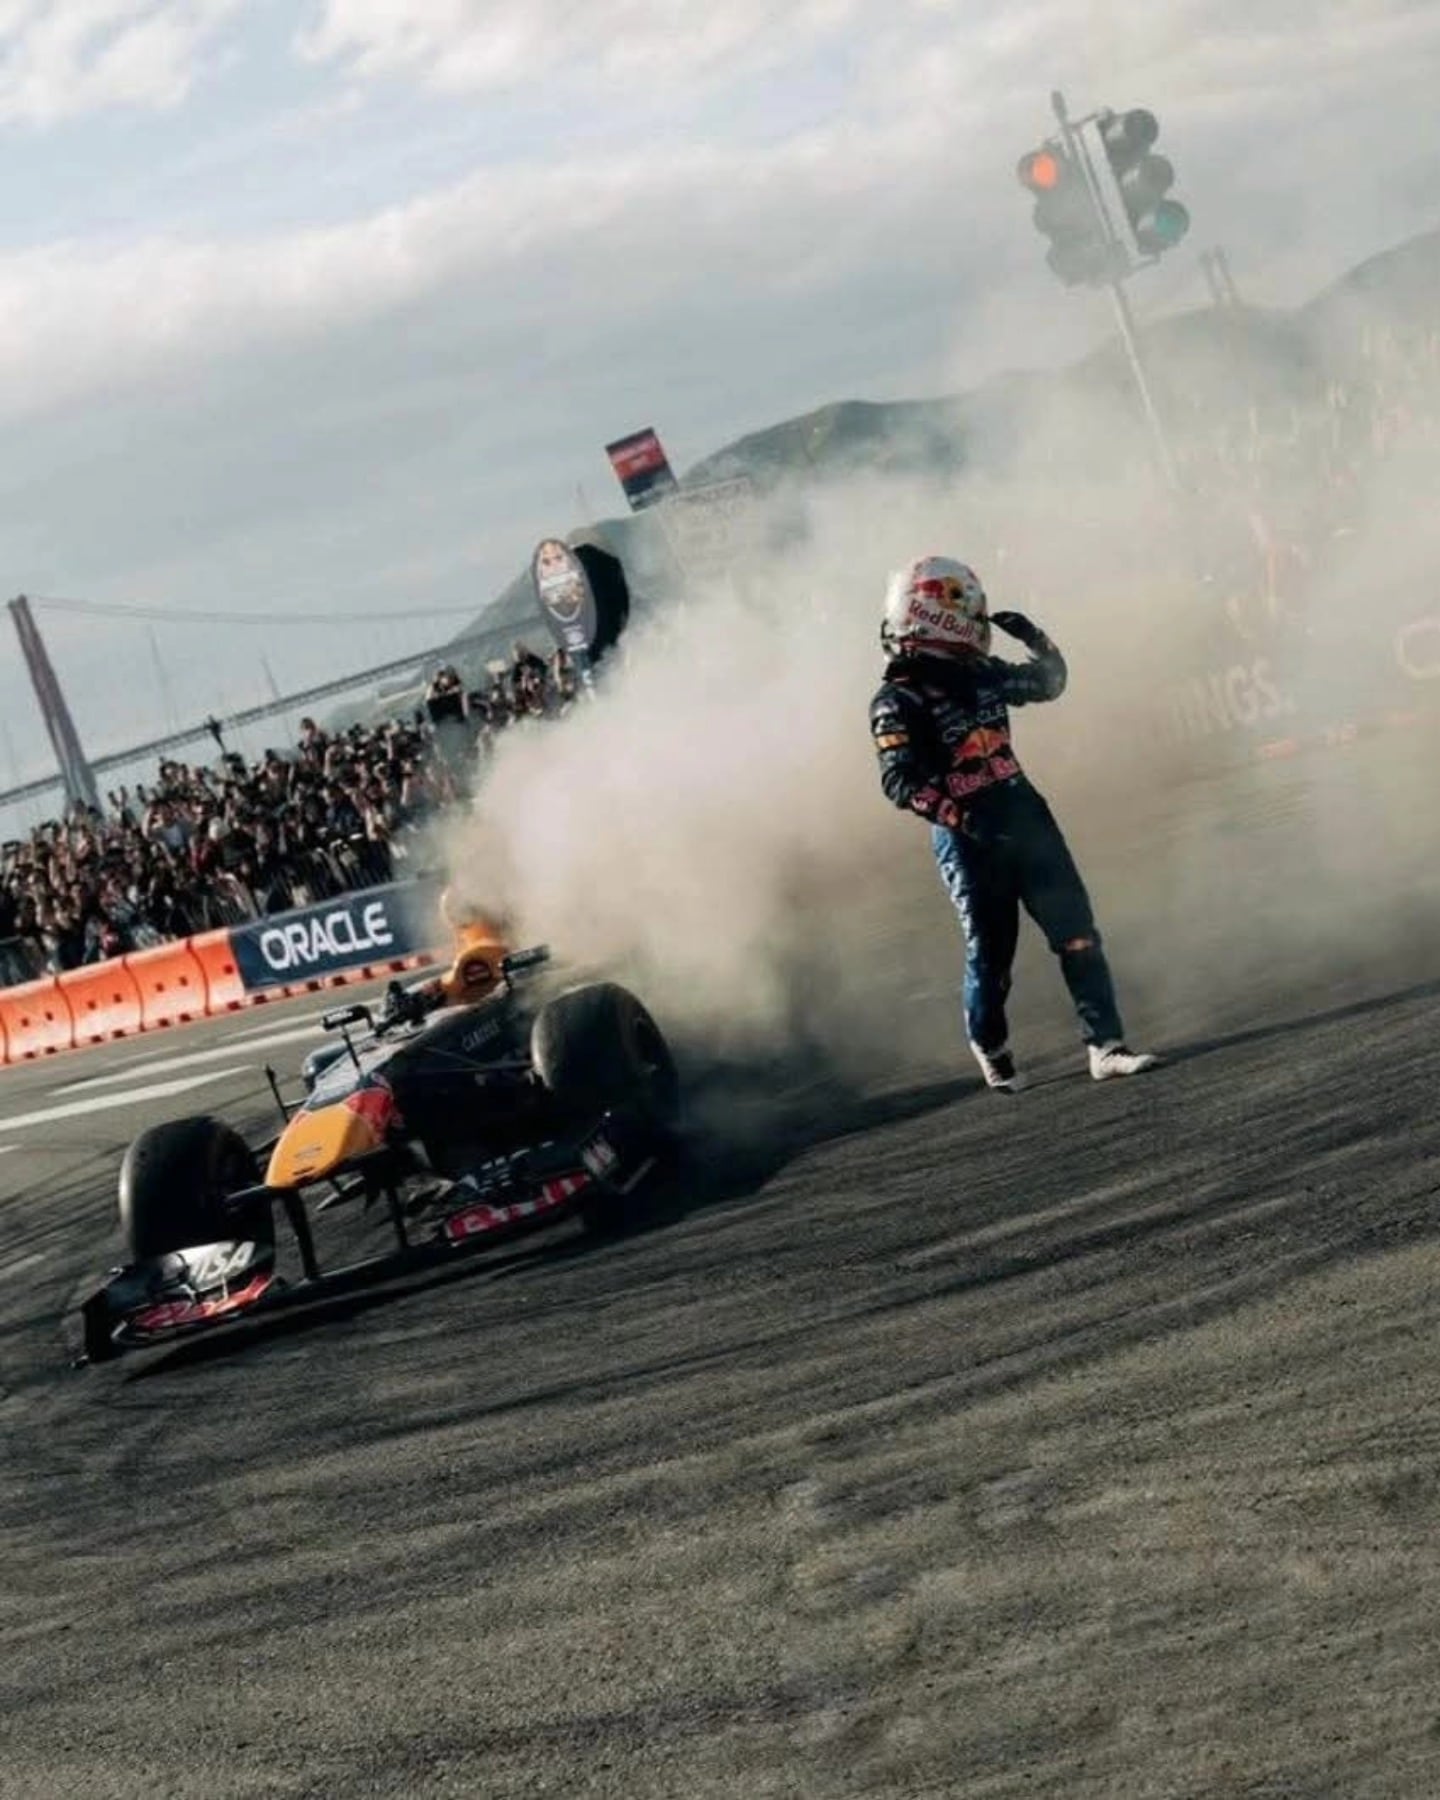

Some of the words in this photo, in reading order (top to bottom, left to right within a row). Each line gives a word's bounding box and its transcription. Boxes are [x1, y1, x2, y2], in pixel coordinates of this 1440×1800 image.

[909, 599, 942, 627] Red
[943, 612, 975, 640] Bull
[260, 901, 394, 971] ORACLE
